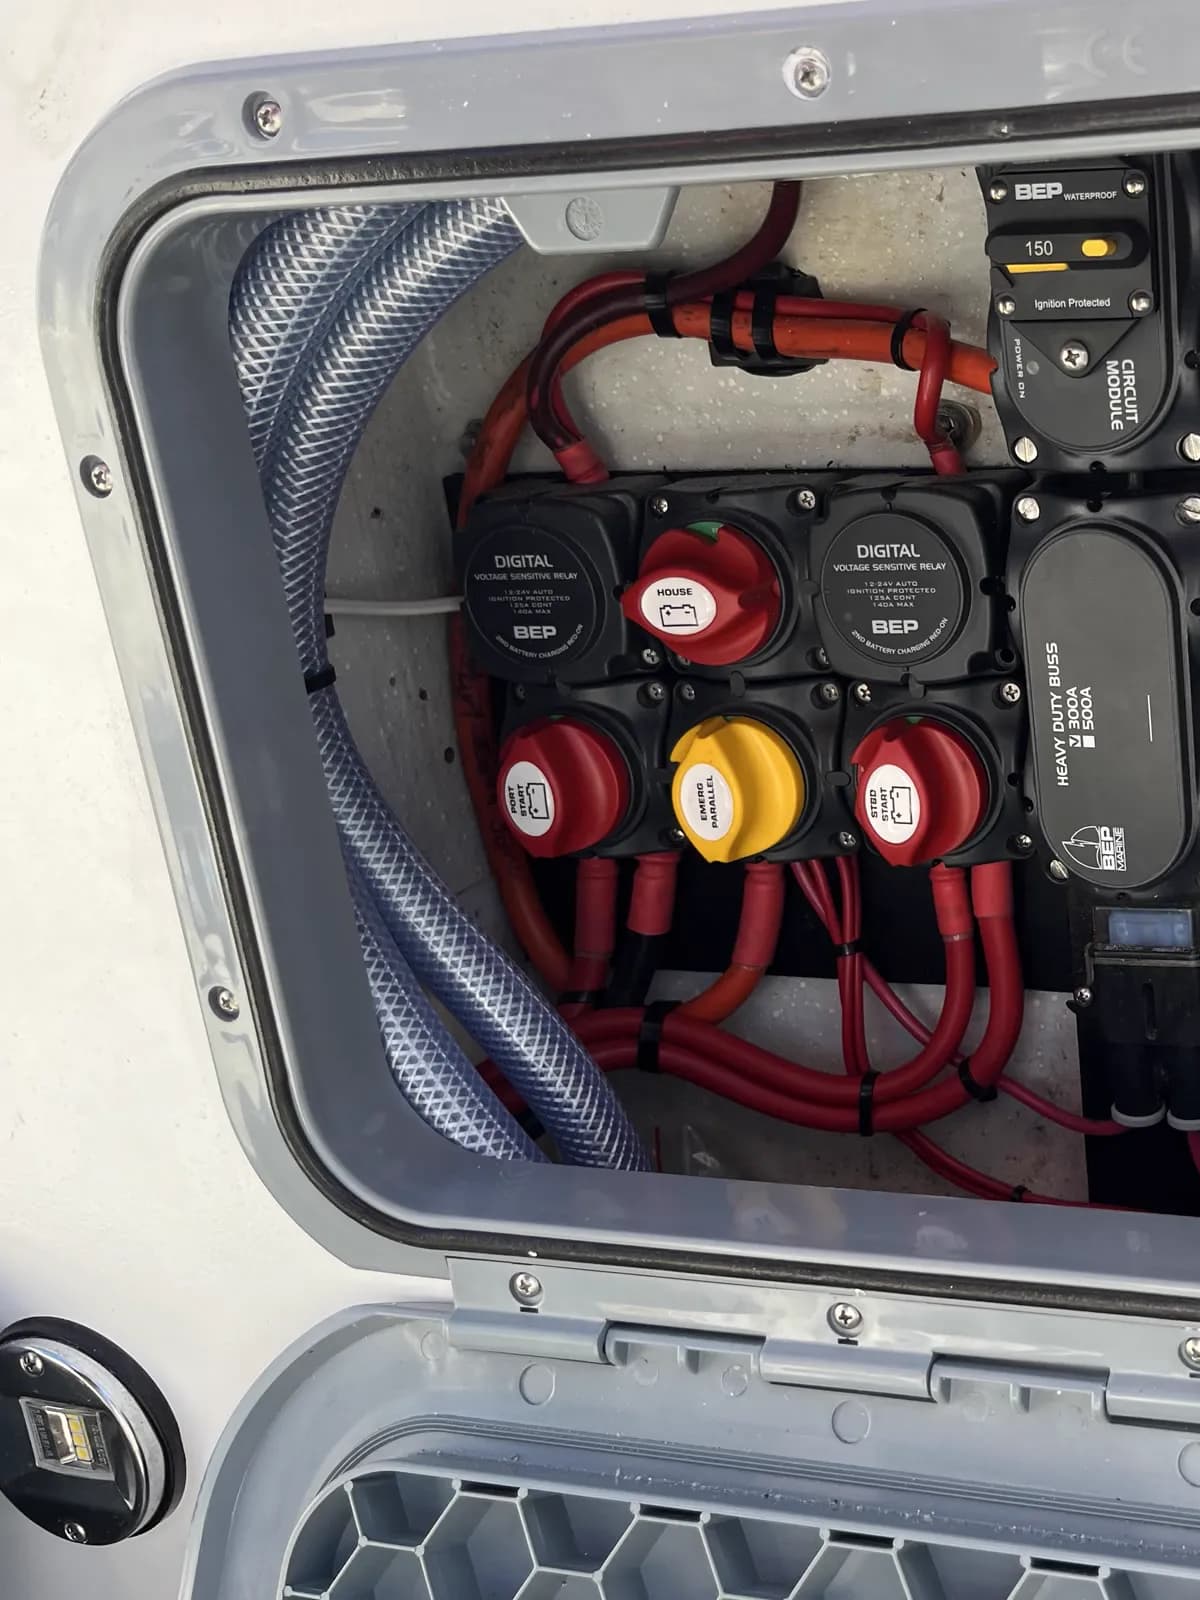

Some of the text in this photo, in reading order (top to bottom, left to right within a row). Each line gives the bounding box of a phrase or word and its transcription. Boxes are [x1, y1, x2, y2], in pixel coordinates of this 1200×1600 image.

[1015, 182, 1118, 201] BEP WATERPROOF
[1025, 240, 1054, 257] 150
[1034, 297, 1111, 310] Ignition Protected
[1013, 338, 1025, 399] POWER ON
[1106, 359, 1124, 431] MODULE
[1121, 358, 1139, 424] CIRCUIT
[494, 554, 554, 568] DIGITAL
[856, 543, 921, 559] DIGITAL
[474, 572, 578, 581] VOLTAGE SENSITIVE RELAY
[833, 562, 947, 572] VOLTAGE SENSITIVE RELAY
[656, 587, 693, 597] HOUSE
[513, 625, 557, 639] BEP
[871, 619, 919, 634] BEP
[508, 644, 538, 659] BATTERY
[865, 640, 897, 655] BATTERY
[896, 640, 931, 655] CHARGING
[1045, 641, 1070, 787] HEAVY DUTY BUSS
[1066, 686, 1081, 730] 300A
[1080, 686, 1095, 730] 500A
[507, 786, 518, 814] PORT
[517, 783, 527, 817] START
[696, 782, 708, 821] EMERG
[706, 775, 720, 829] PARALLEL
[869, 789, 878, 819] STBD
[880, 786, 889, 822] START
[1100, 826, 1116, 870] BEP
[1113, 827, 1127, 872] MARINE
